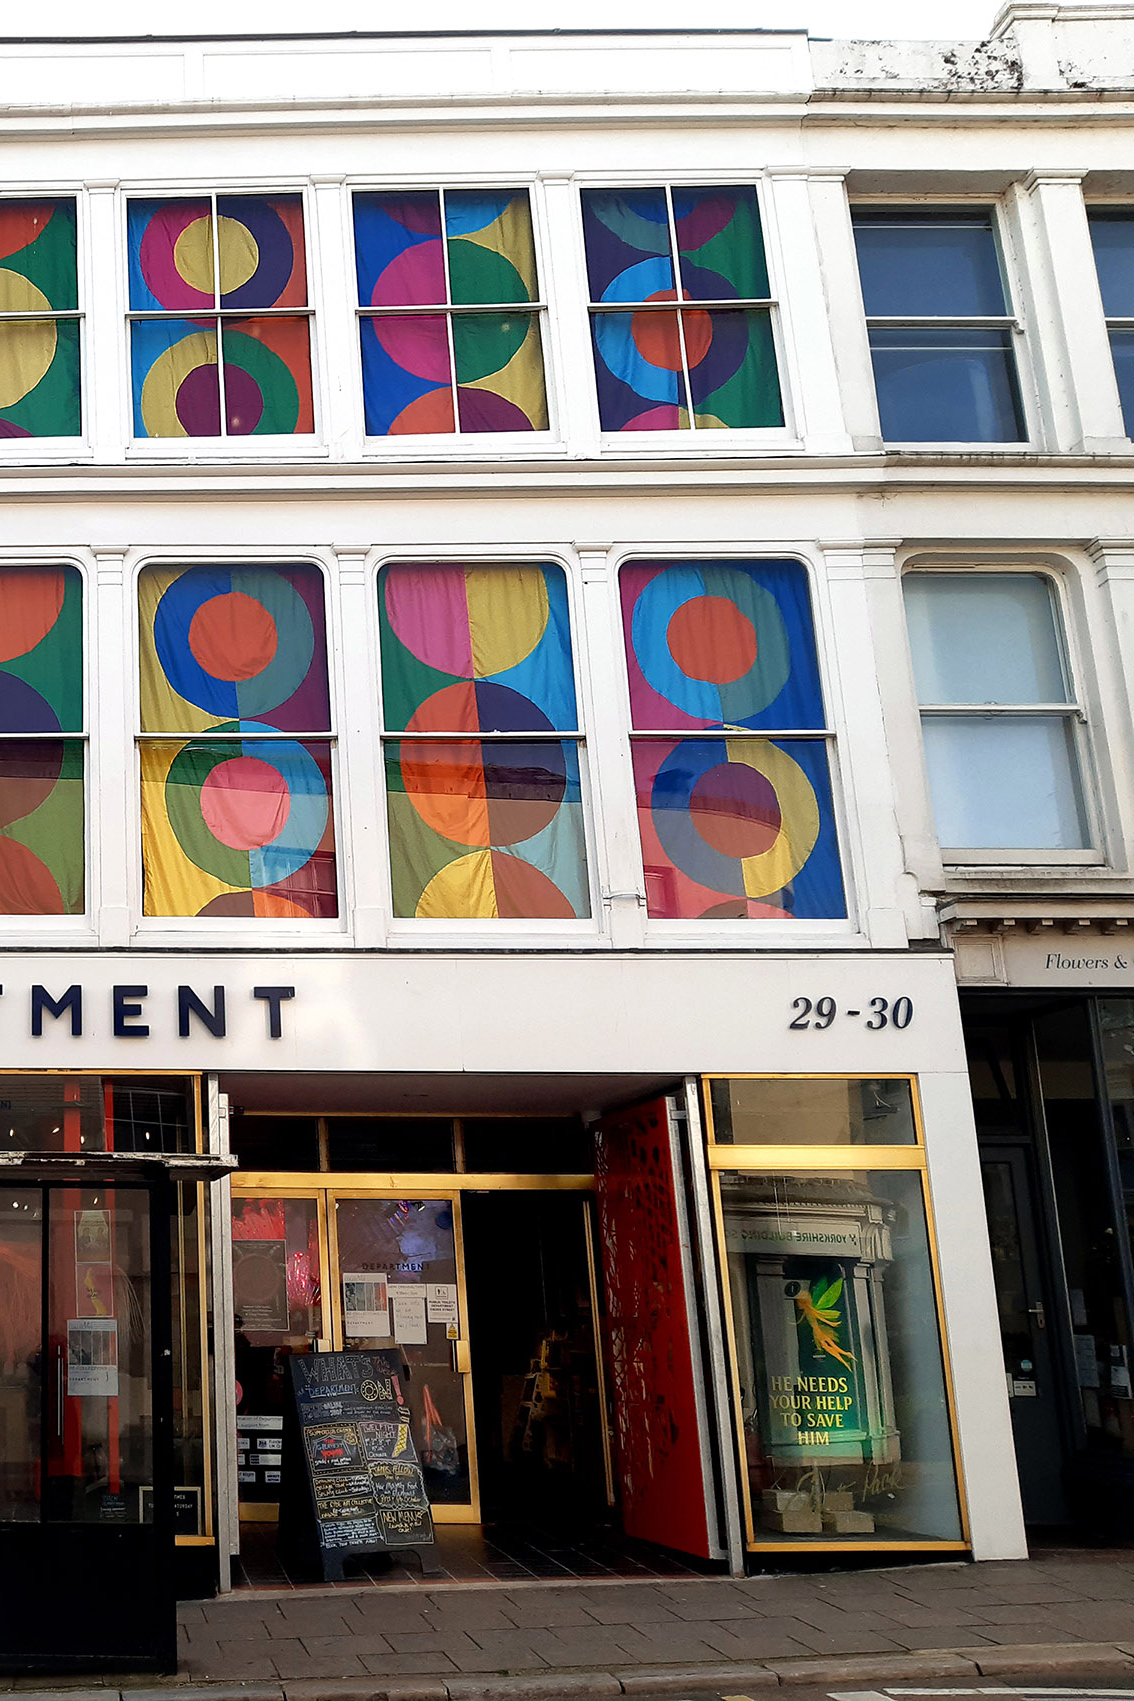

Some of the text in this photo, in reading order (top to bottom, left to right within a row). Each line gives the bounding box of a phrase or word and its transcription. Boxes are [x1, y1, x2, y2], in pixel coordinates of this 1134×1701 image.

[1045, 953, 1128, 970] Flowers &
[362, 1262, 430, 1271] DEPARTMENT
[771, 1376, 848, 1393] HE NEEDS
[769, 1395, 852, 1410] YOUR HELP
[780, 1413, 844, 1428] TO SAVE
[797, 1431, 830, 1445] HIM
